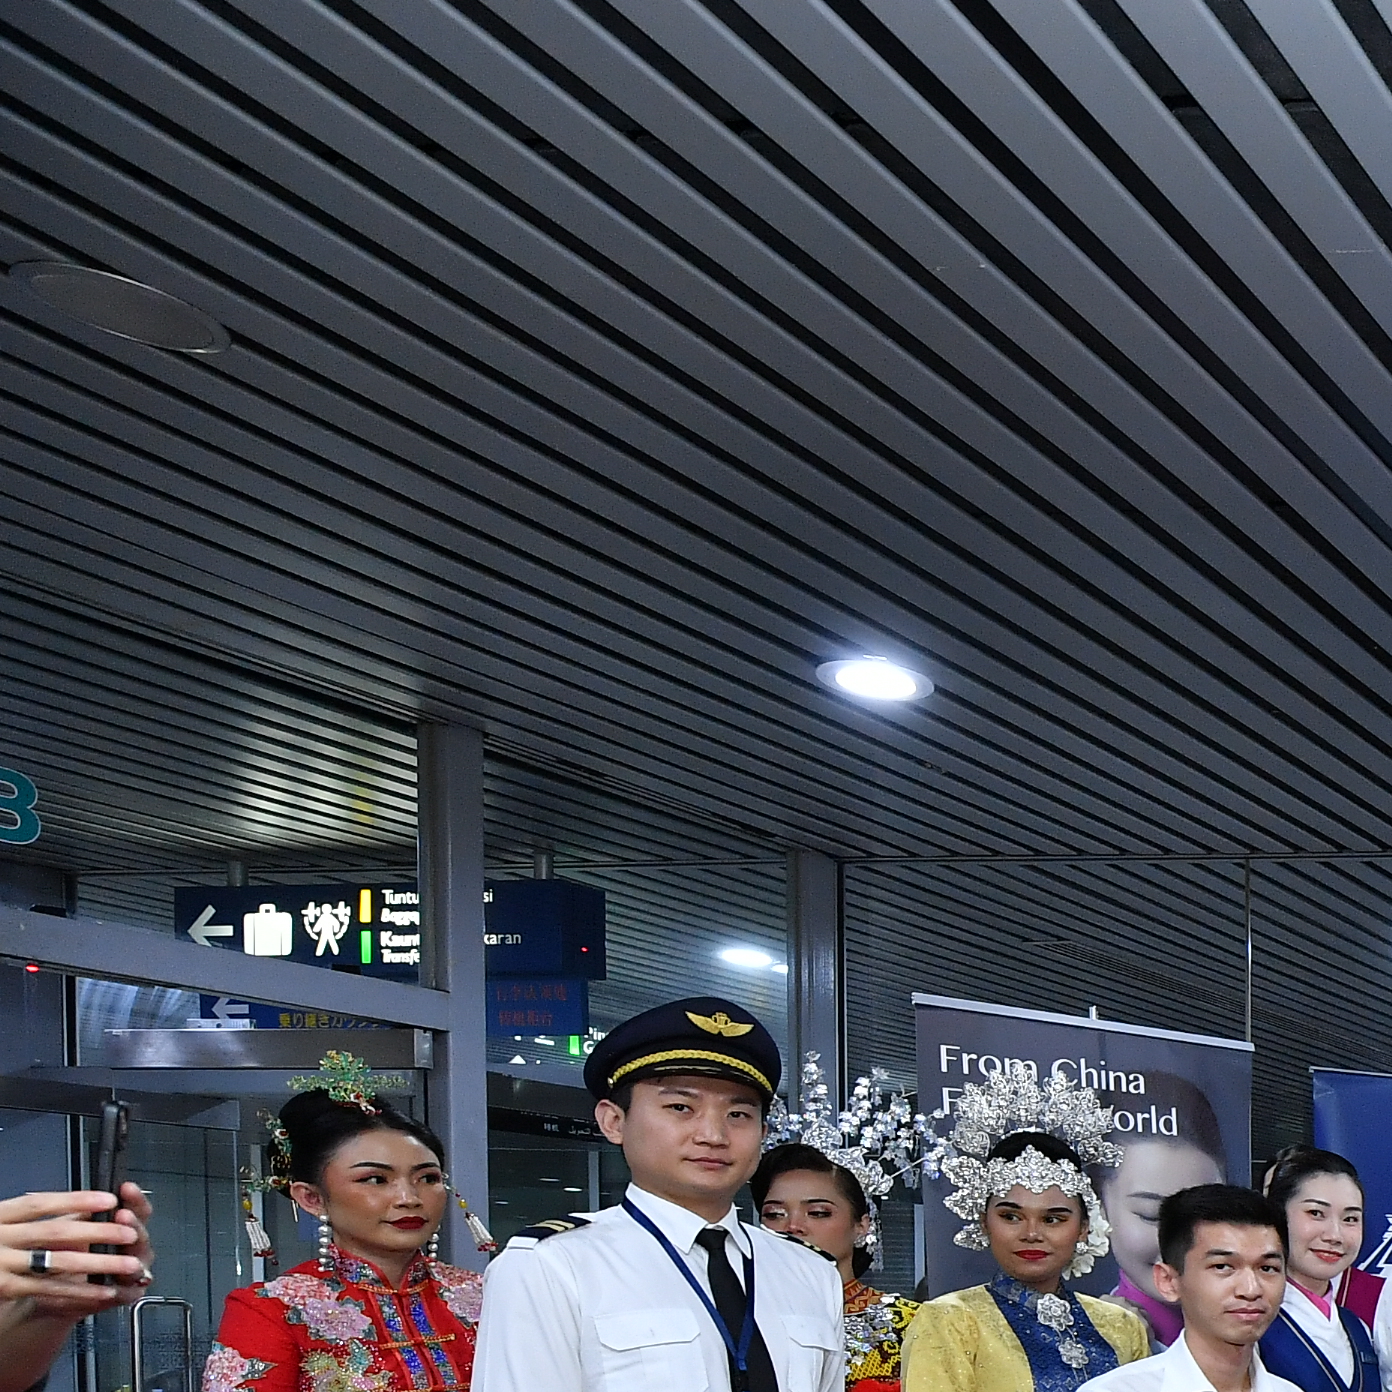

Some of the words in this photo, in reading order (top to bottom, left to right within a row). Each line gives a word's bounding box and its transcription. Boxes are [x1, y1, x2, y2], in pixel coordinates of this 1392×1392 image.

[381, 889, 420, 905] Tuntu
[940, 1044, 1038, 1080] From
[1051, 1058, 1145, 1094] China
[1112, 1104, 1179, 1136] orld
